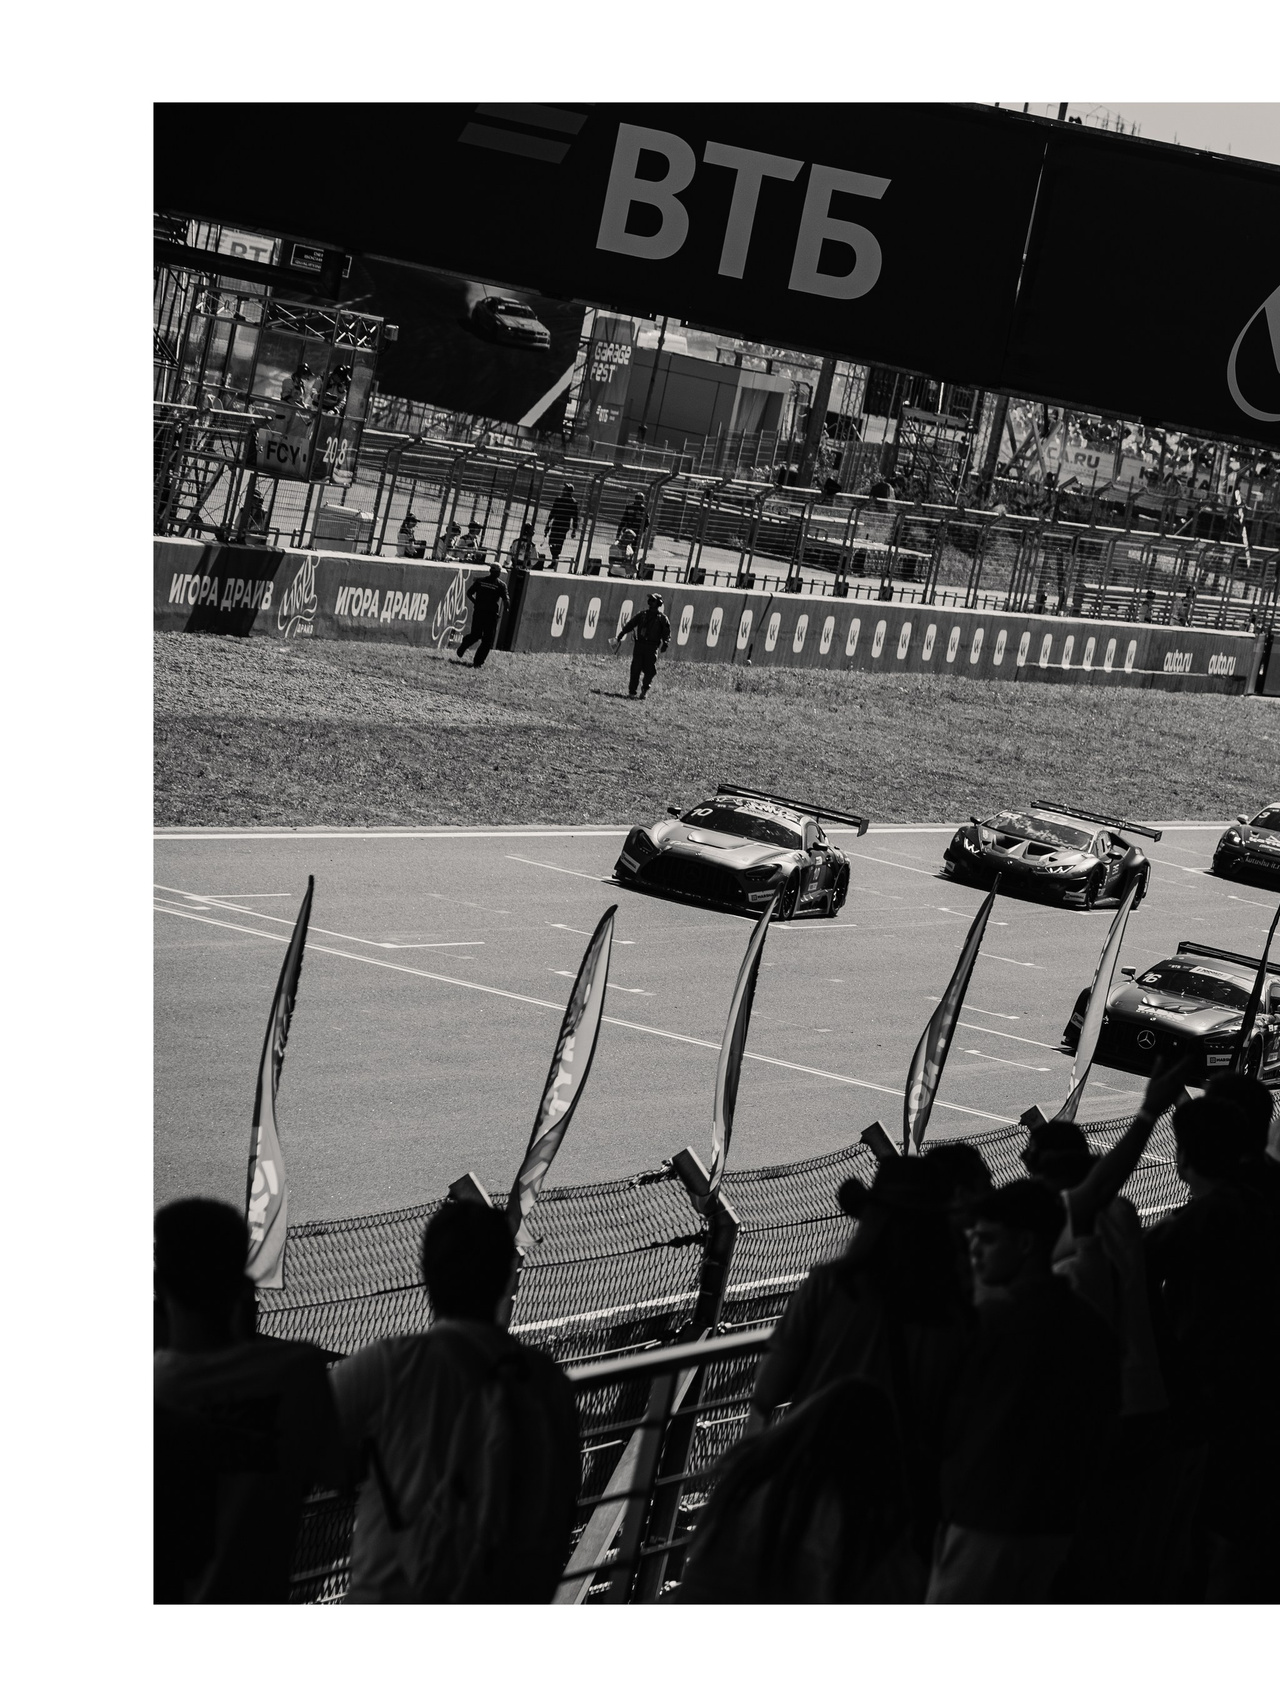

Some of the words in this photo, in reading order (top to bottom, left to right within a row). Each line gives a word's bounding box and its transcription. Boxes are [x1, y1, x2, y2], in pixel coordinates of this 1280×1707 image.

[596, 122, 892, 299] ВТБ
[266, 440, 299, 465] FCY
[169, 573, 218, 606] ИГОРА
[334, 586, 380, 618] ИГОРА
[691, 807, 713, 816] 10
[1142, 972, 1162, 983] 16
